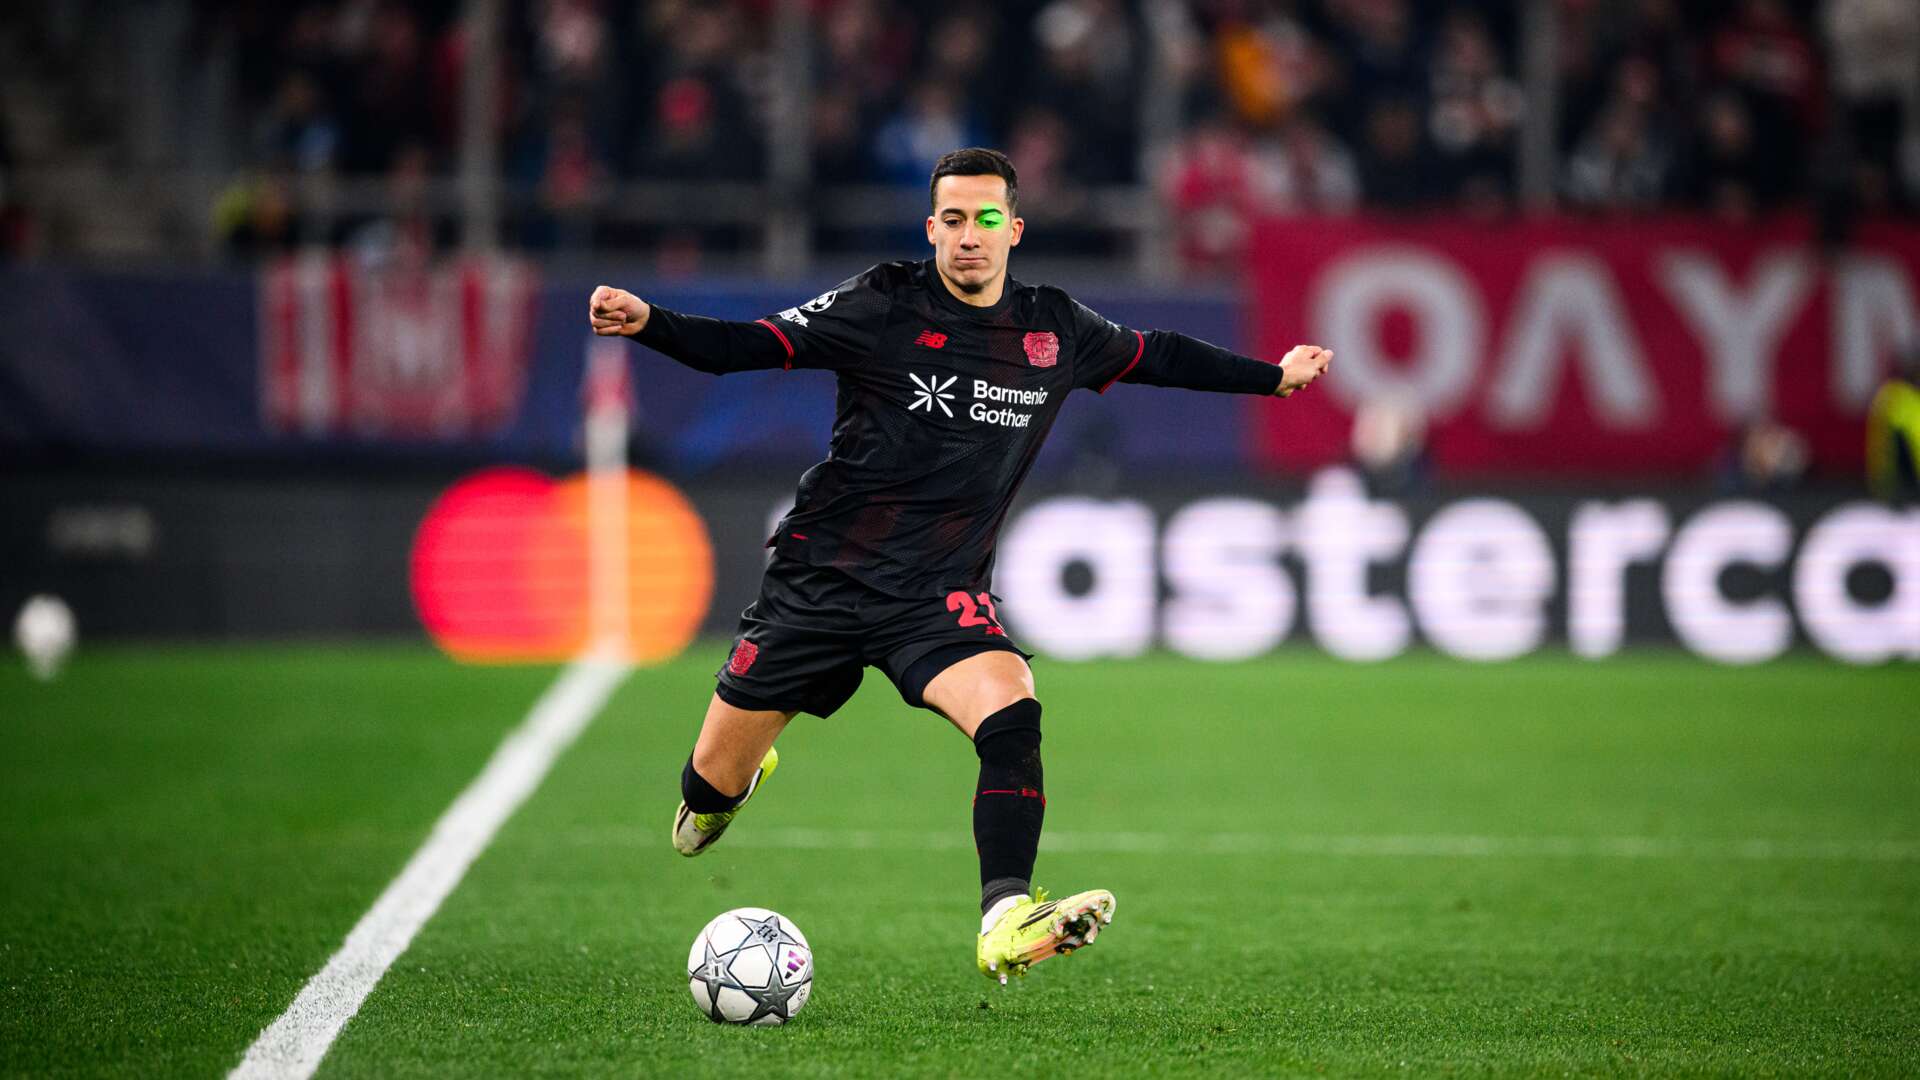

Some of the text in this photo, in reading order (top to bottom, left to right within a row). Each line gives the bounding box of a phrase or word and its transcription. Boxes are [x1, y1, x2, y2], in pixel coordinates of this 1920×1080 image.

[973, 379, 1048, 405] Barmenia
[969, 402, 1032, 427] Gothaer
[766, 466, 1920, 664] asterca
